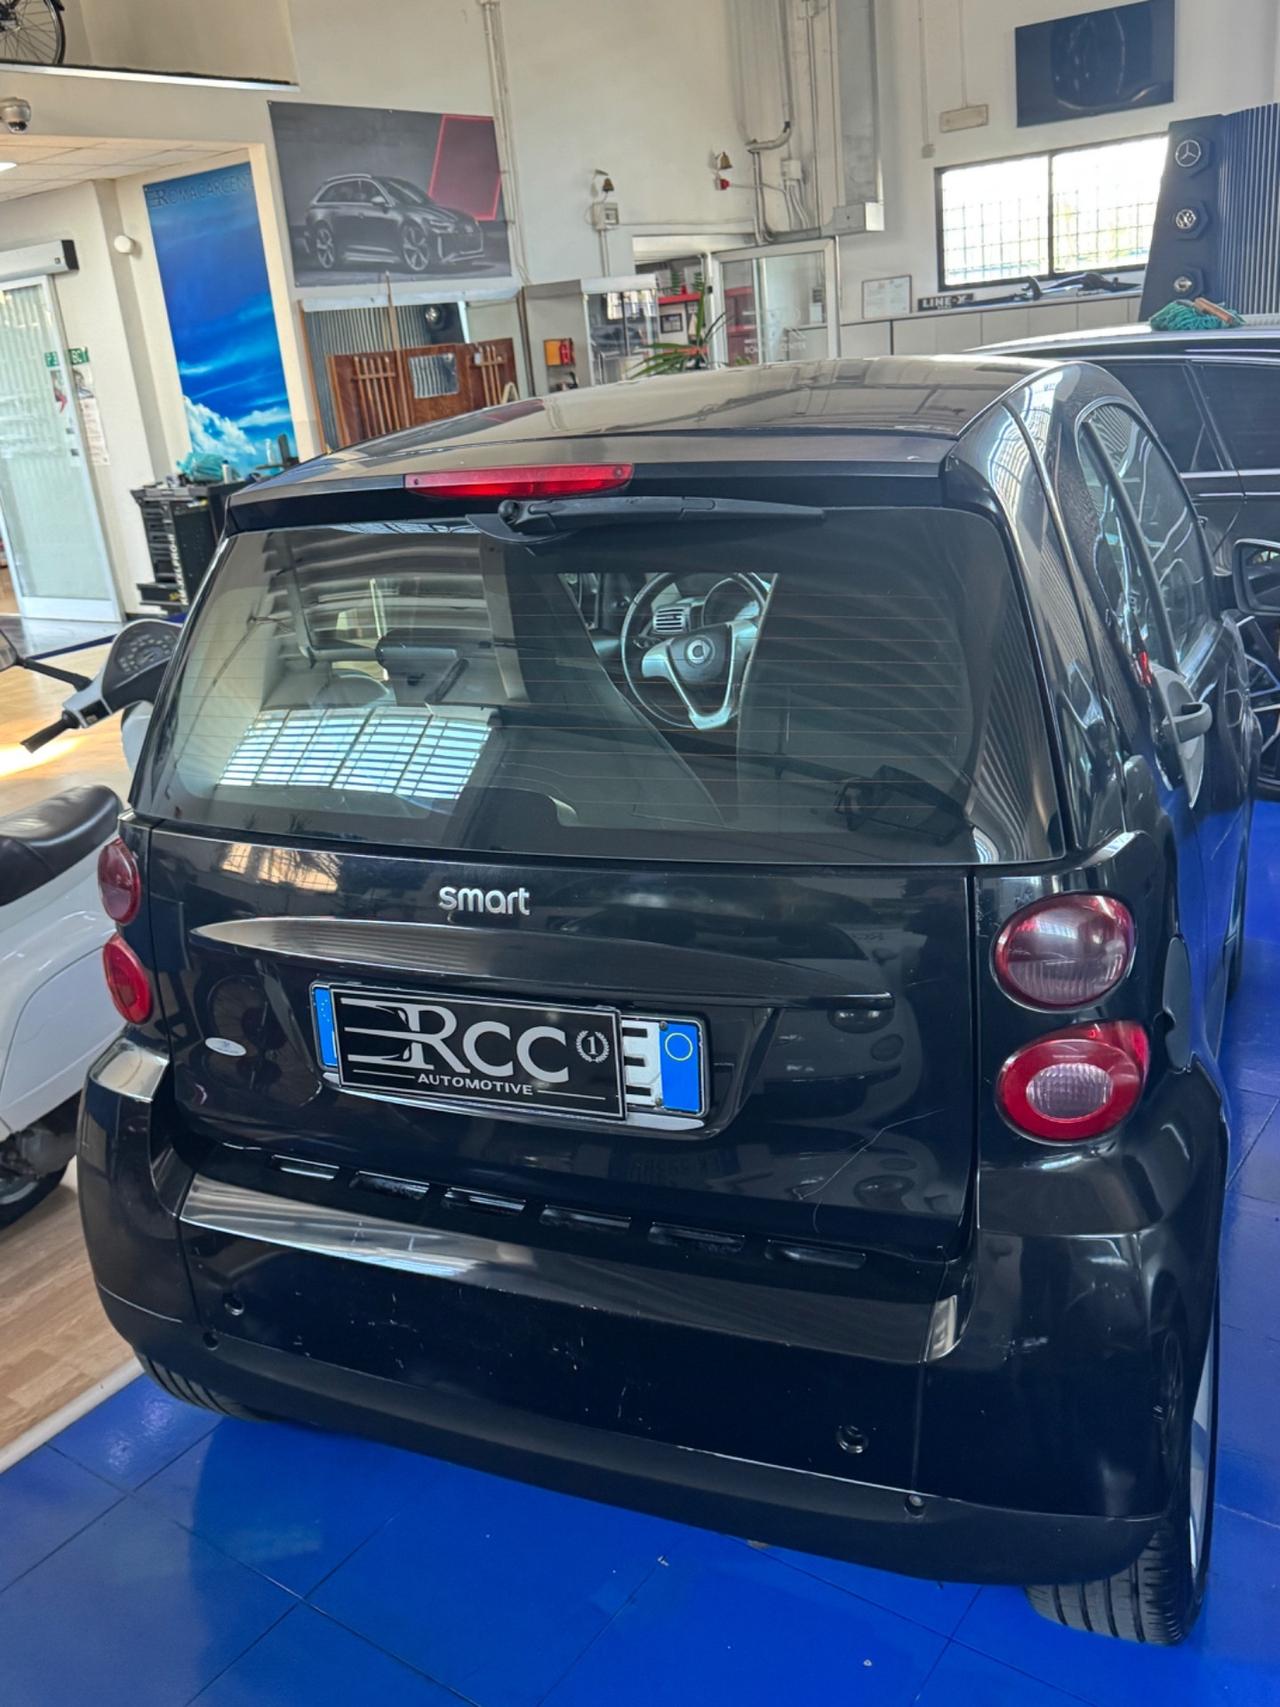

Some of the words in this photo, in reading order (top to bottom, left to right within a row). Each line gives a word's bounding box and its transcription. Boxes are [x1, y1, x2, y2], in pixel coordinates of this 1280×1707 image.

[438, 885, 530, 916] smart
[341, 997, 570, 1083] RCC
[416, 1073, 534, 1096] AUTOMOTIVE
